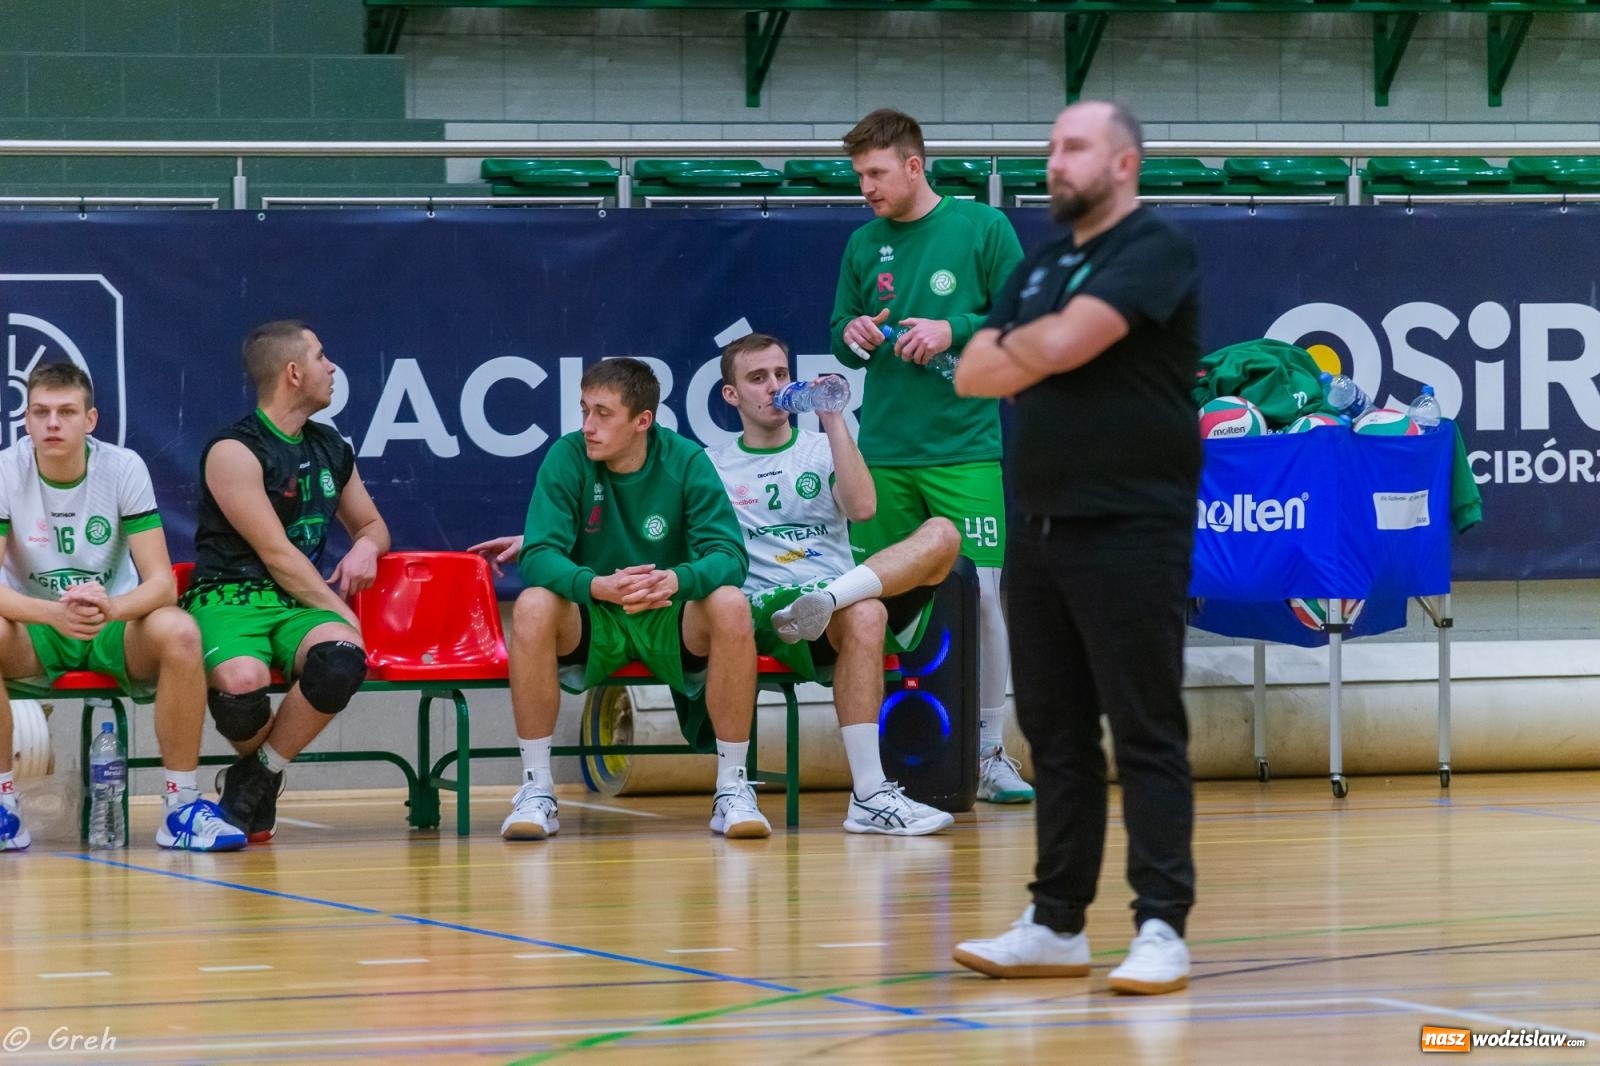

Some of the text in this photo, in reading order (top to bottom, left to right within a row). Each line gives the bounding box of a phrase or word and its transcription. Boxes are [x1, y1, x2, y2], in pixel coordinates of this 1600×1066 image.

[1213, 425, 1247, 437] molten
[765, 483, 783, 511] 2
[53, 526, 75, 555] 16
[964, 516, 998, 547] 49
